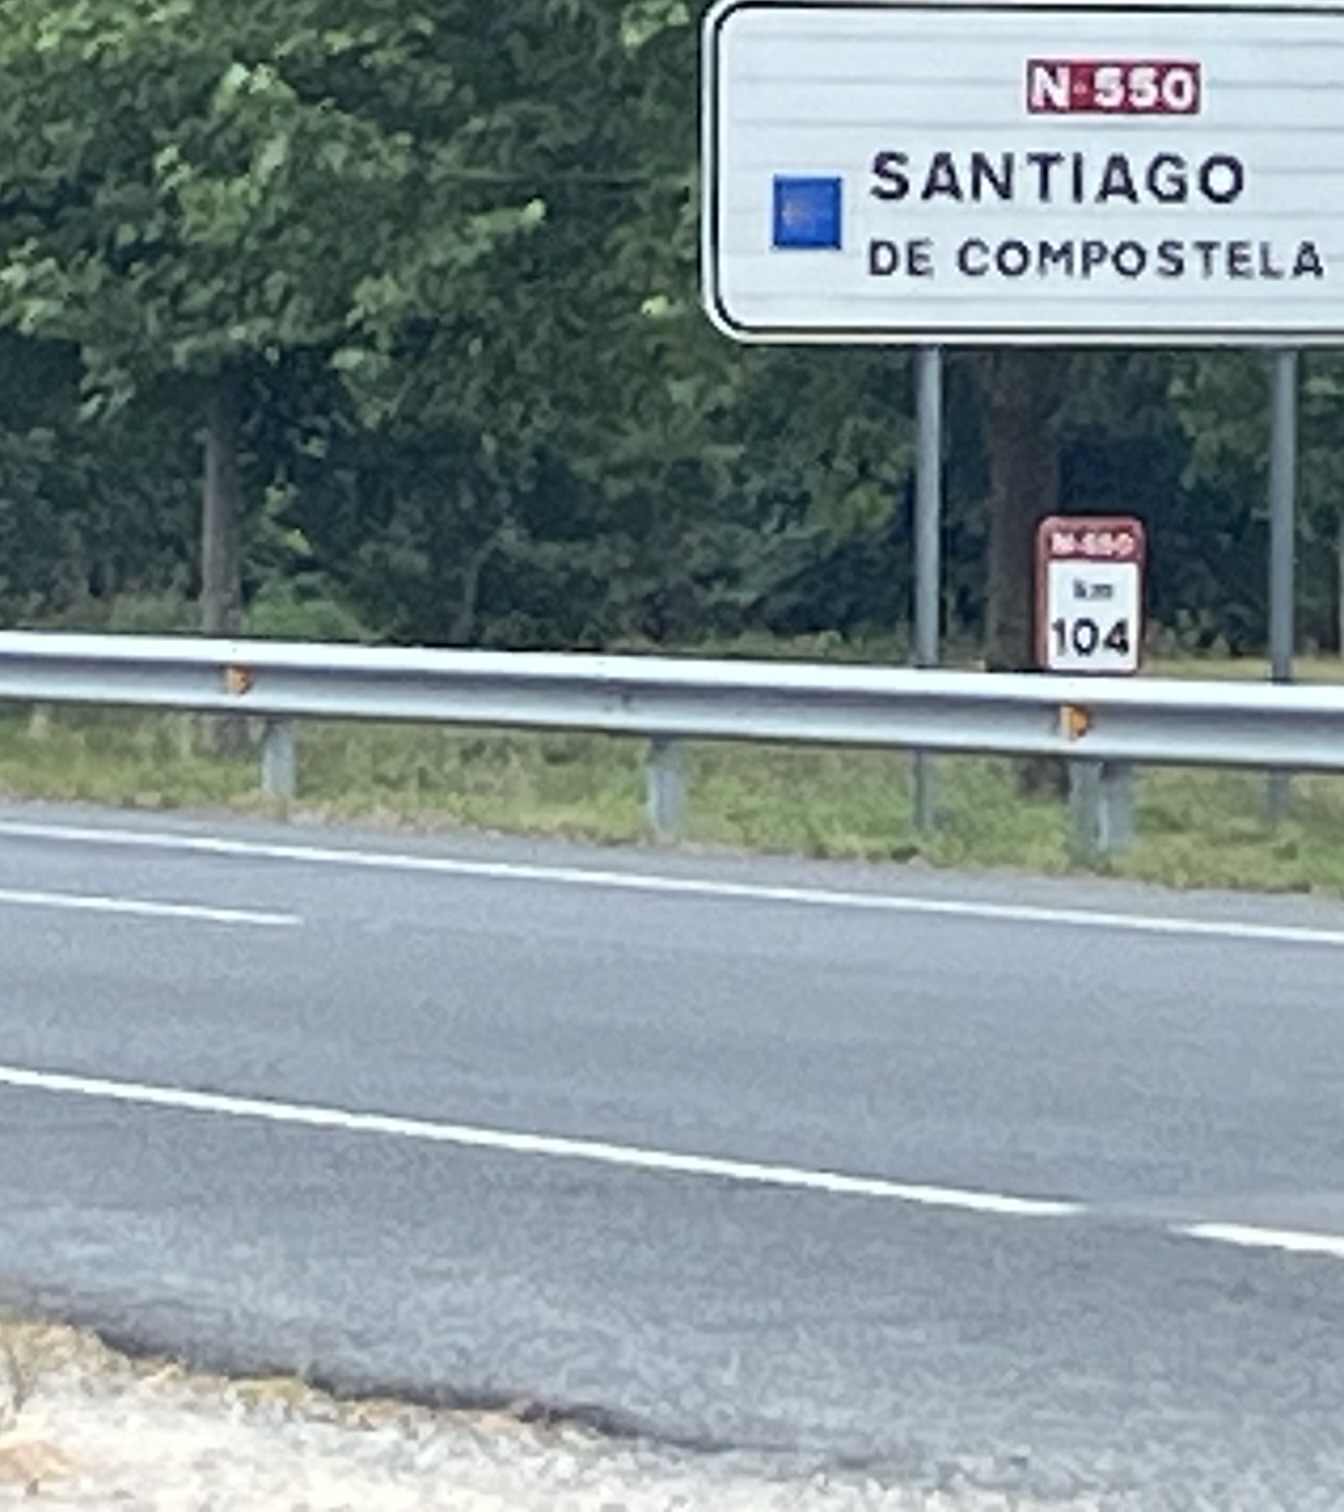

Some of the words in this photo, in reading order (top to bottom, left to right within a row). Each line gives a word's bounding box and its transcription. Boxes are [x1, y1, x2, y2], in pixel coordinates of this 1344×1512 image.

[1030, 65, 1195, 110] N-550
[869, 152, 1245, 205] SANTIAGO
[868, 238, 934, 277] DE
[956, 238, 1324, 280] COMPOSTELA
[1072, 579, 1114, 600] km
[1051, 617, 1130, 657] 104
